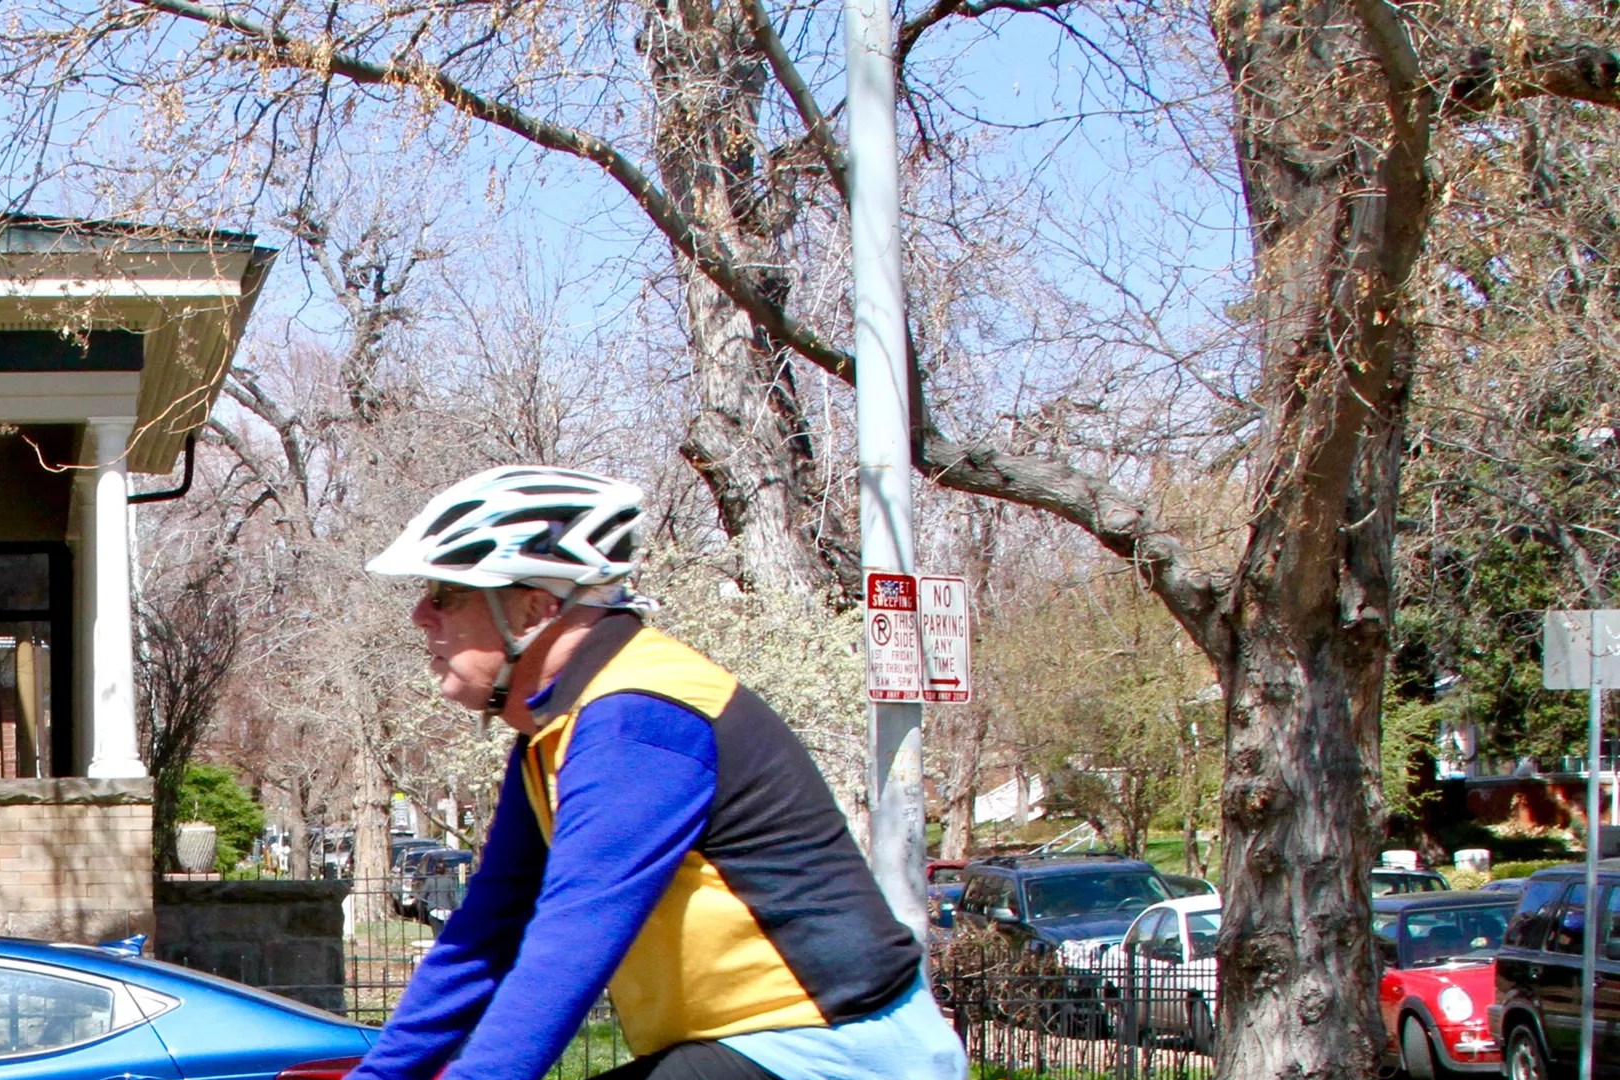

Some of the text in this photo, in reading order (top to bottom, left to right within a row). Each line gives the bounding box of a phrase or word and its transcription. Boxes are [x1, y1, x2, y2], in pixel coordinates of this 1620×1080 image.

[933, 585, 951, 608] NO
[894, 613, 915, 630] THIS
[923, 613, 964, 637] PARKING
[894, 632, 915, 648] SIDE
[934, 639, 953, 654] ANY
[891, 650, 915, 661] FRIDAY
[933, 656, 956, 672] TIME
